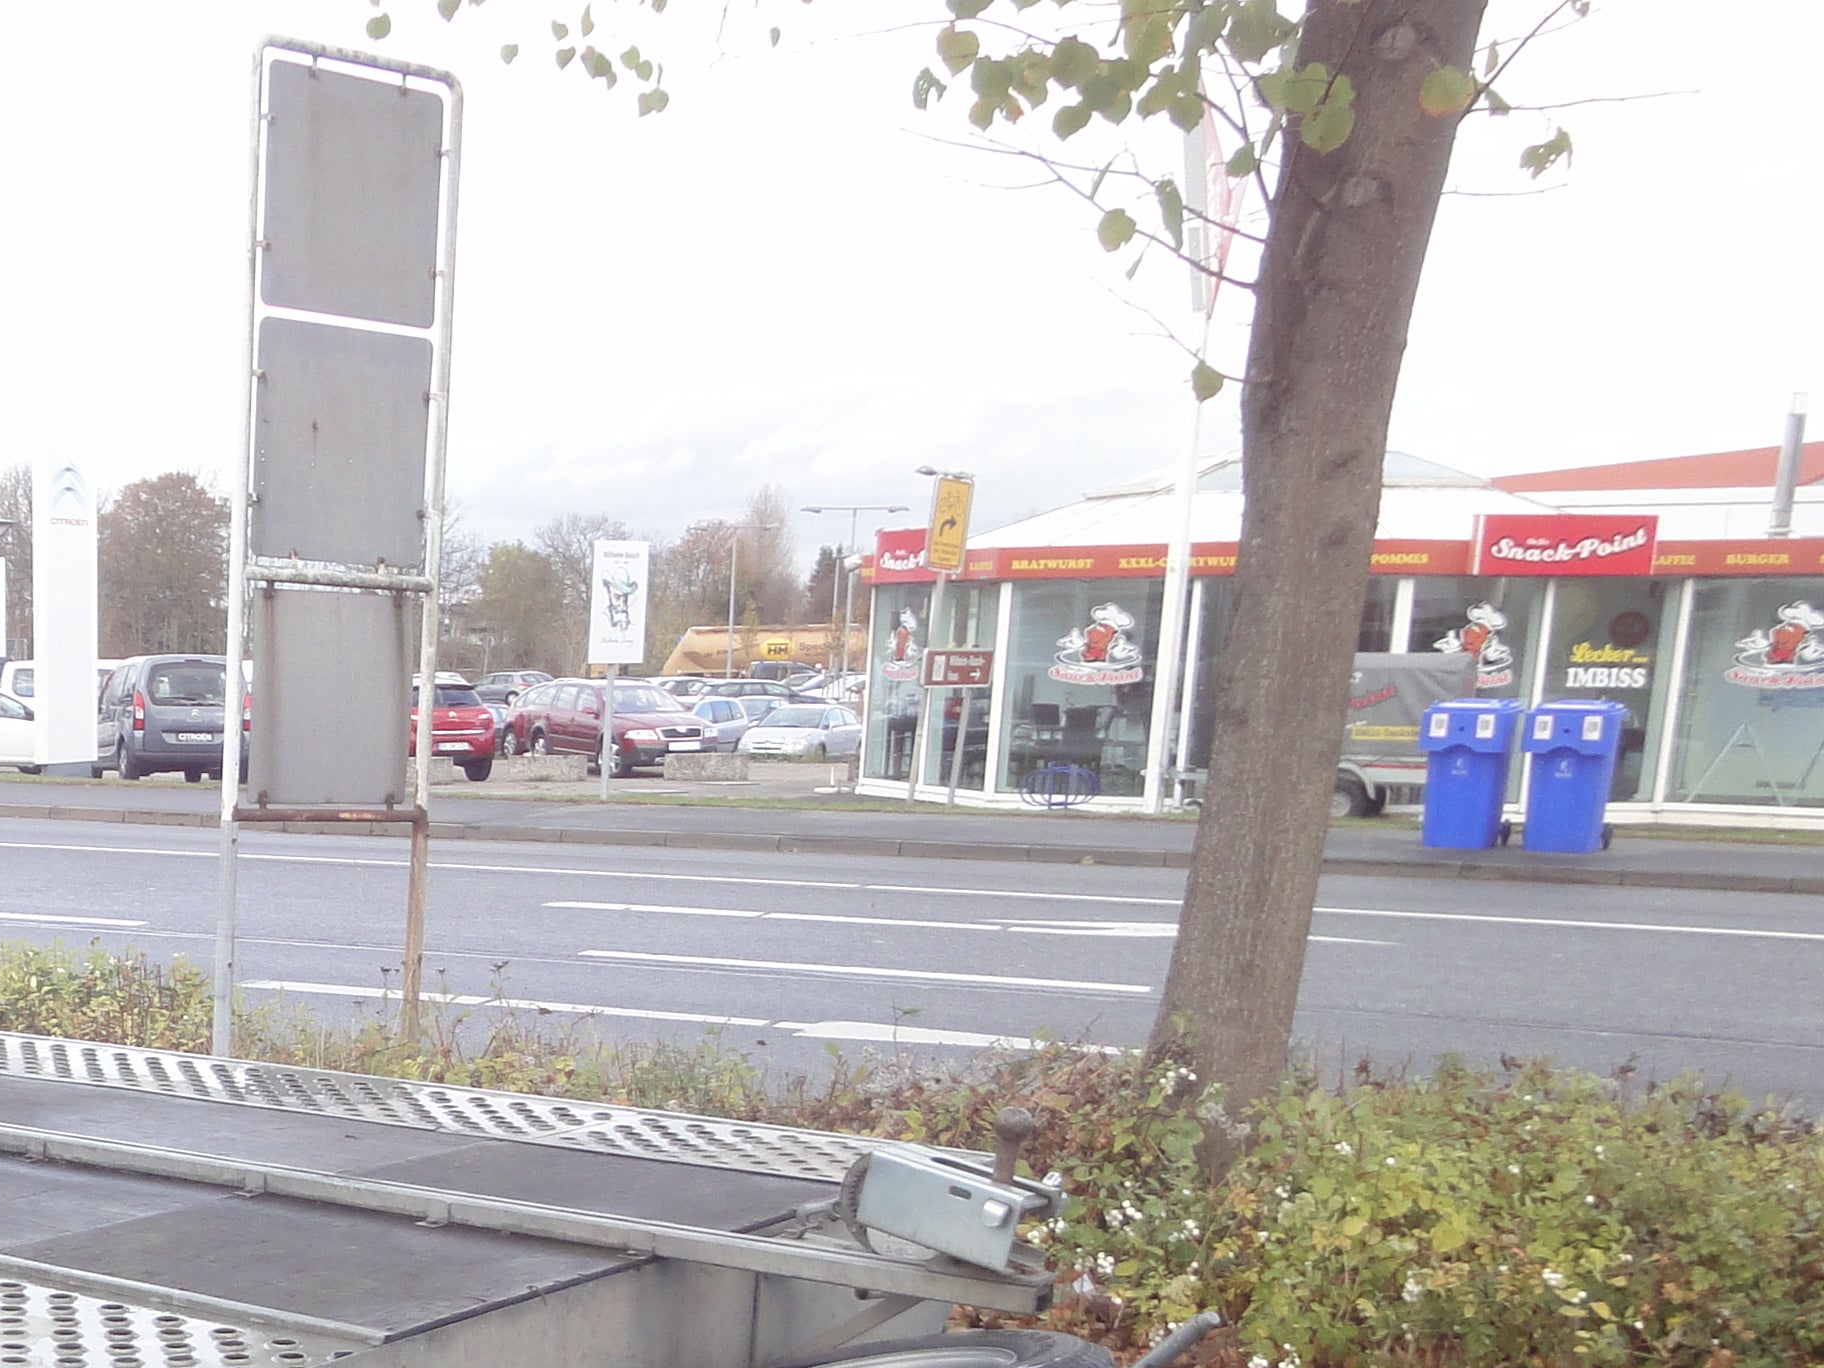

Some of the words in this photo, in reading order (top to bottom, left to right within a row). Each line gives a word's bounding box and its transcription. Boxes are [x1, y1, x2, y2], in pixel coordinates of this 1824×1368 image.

[1371, 553, 1429, 564] POMMES
[1654, 554, 1696, 565] AFFEE
[1725, 554, 1789, 564] BURGER
[1011, 559, 1094, 570] BRATWURST
[1564, 666, 1647, 688] IMBISS
